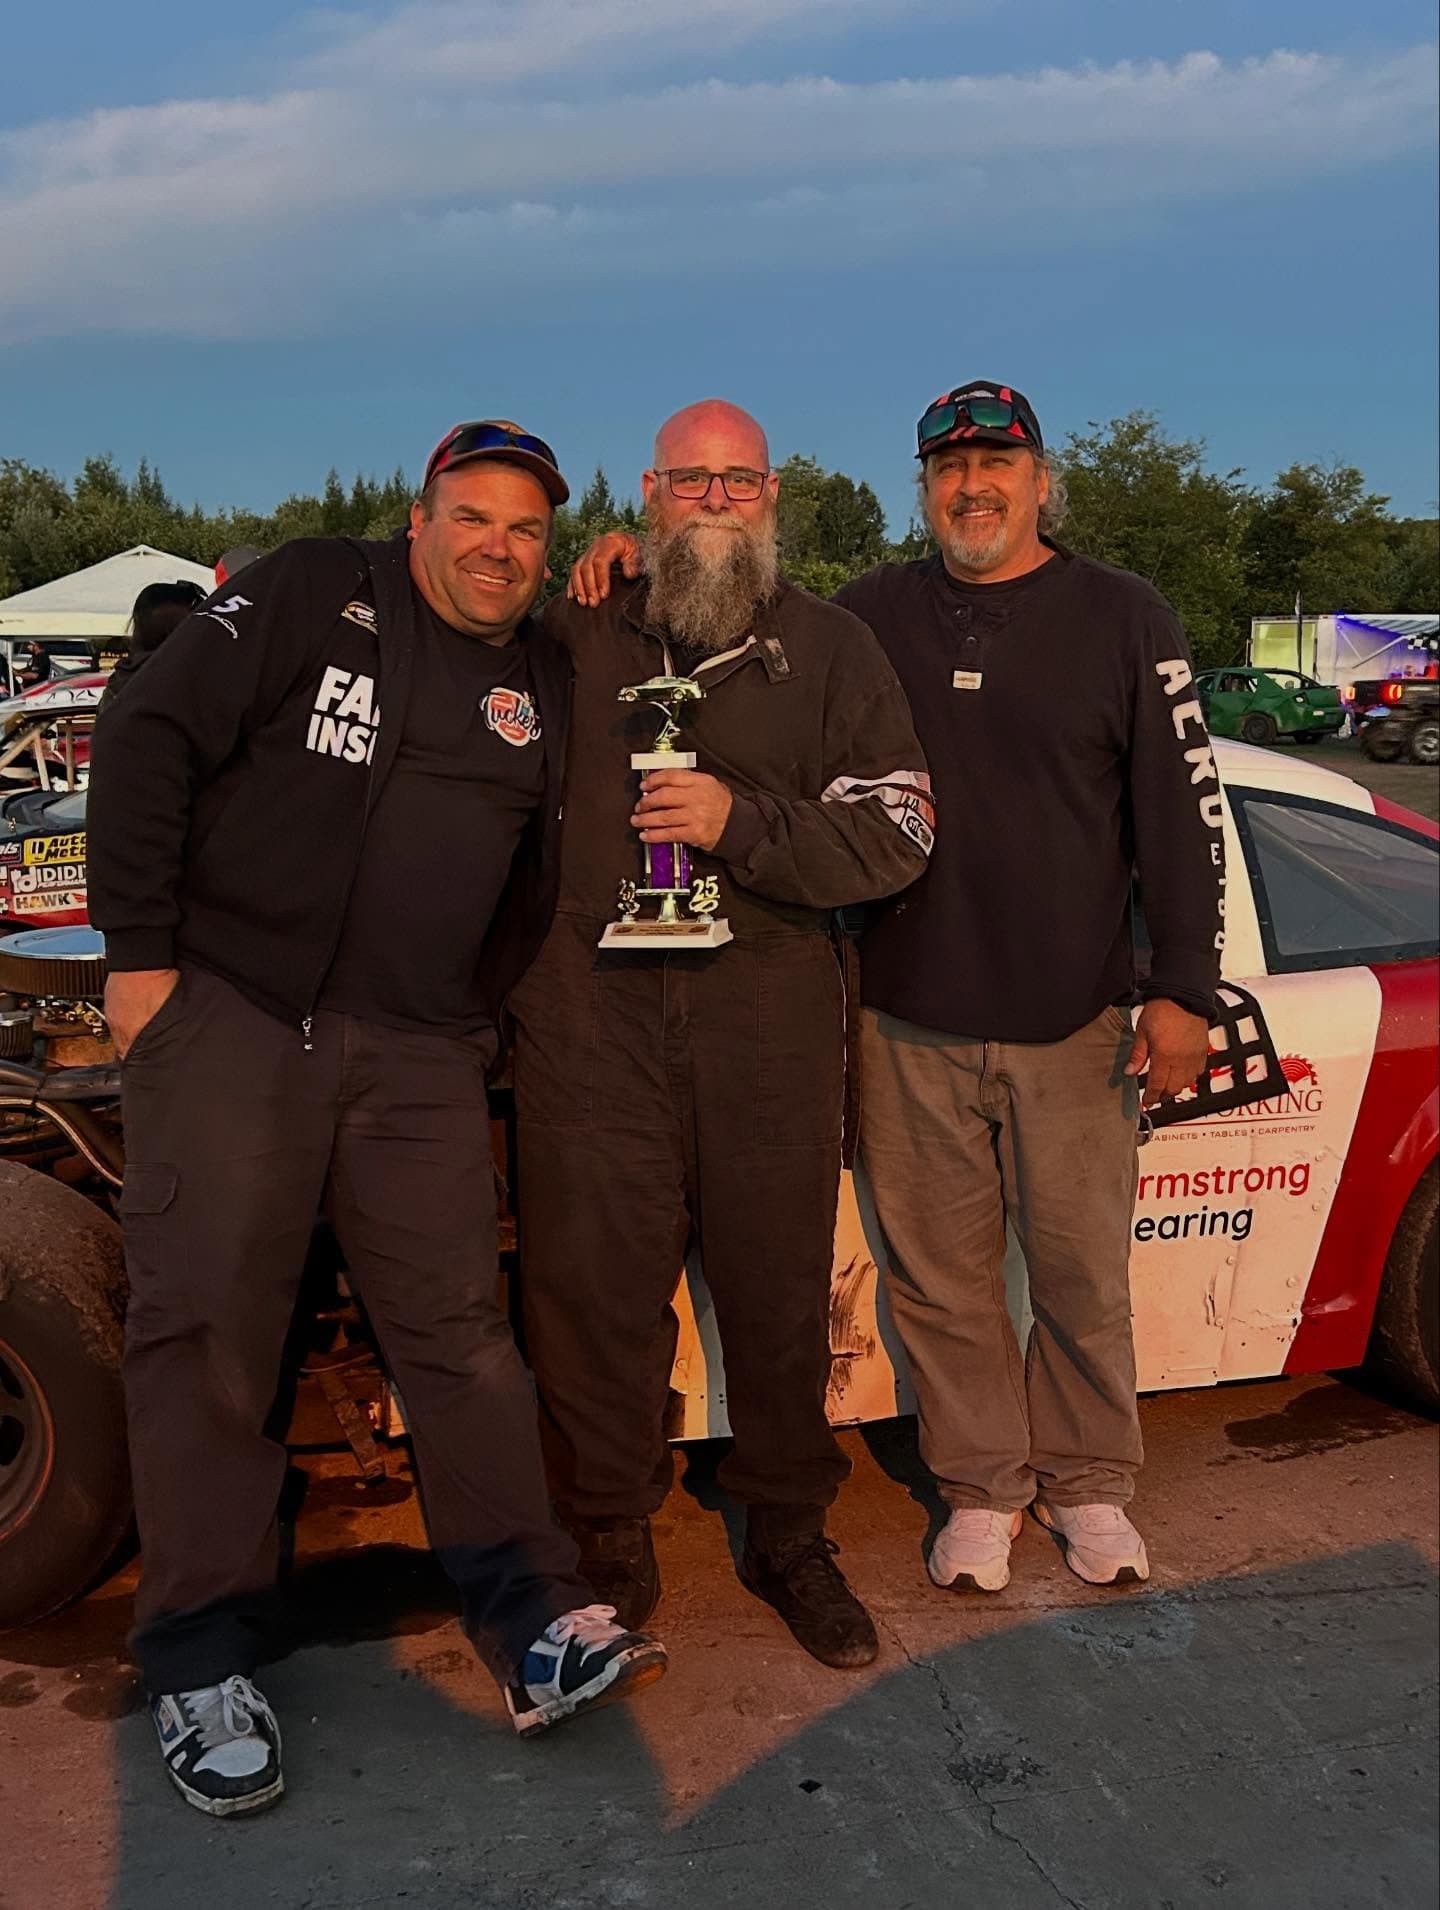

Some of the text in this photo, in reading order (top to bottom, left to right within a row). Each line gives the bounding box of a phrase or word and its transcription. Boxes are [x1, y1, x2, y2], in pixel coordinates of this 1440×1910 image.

[314, 665, 381, 727] FA
[1150, 1125, 1316, 1142] ABINETS TABLES CARPENTRY
